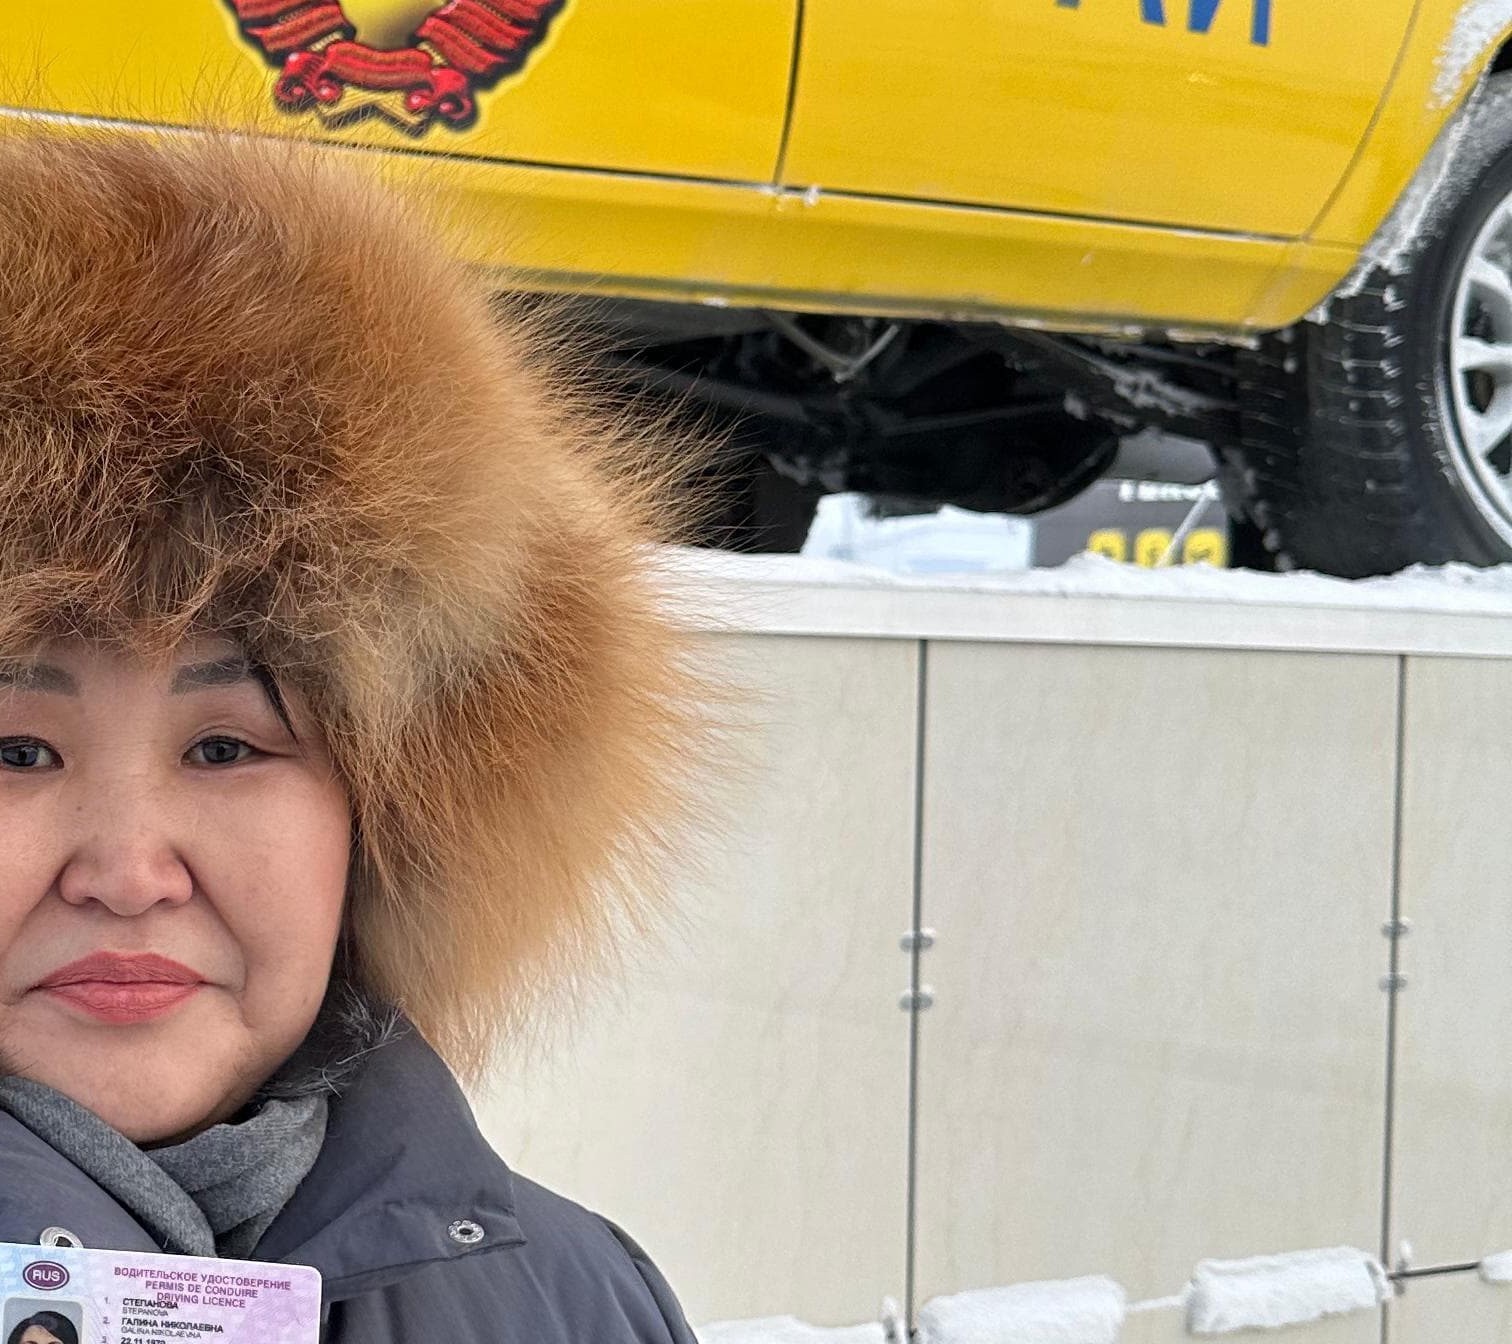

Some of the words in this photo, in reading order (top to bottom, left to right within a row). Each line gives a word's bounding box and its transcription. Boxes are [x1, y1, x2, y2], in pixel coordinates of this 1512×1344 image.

[32, 1269, 61, 1282] RUS
[114, 1267, 198, 1282] ВОДИТЕЛЬСКОЕ
[201, 1273, 291, 1290] УДОСТОВЕРЕНИЕ
[145, 1280, 184, 1292] PERMIS
[188, 1283, 201, 1293] DE
[205, 1285, 258, 1298] CONDUIRE
[122, 1298, 178, 1309] СТЕПАНОВА
[157, 1292, 199, 1305] DRIVING
[203, 1294, 246, 1308] LICENCE
[122, 1307, 168, 1316] STEPANOVA
[121, 1318, 158, 1328] ГАЛИНА
[161, 1320, 224, 1333] НИКОЛАЕВНА
